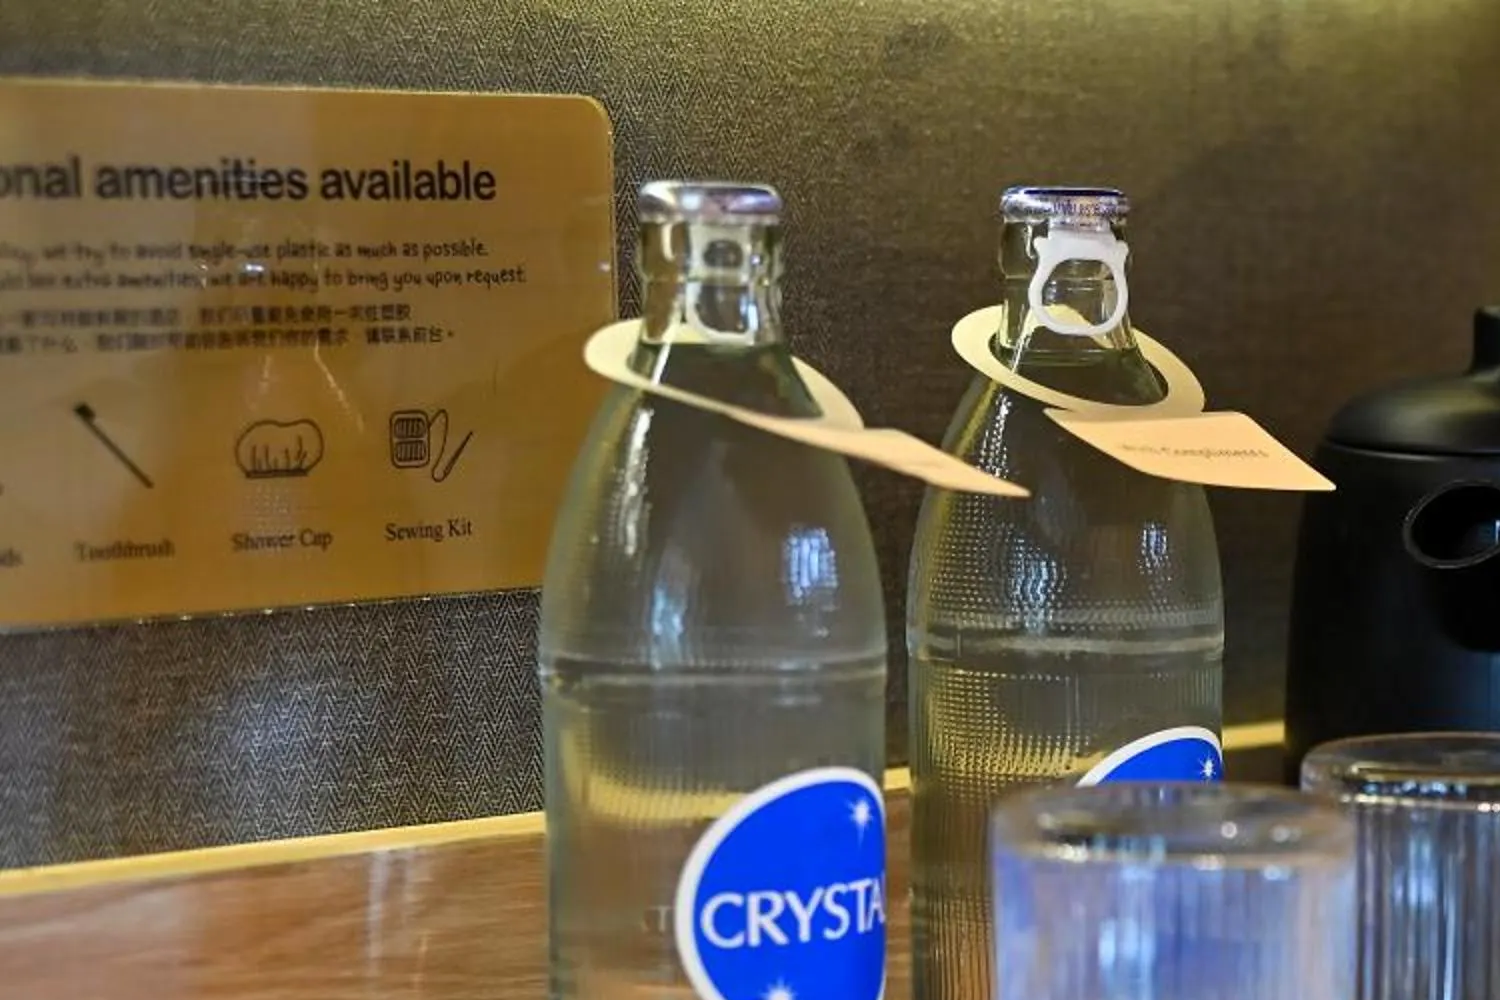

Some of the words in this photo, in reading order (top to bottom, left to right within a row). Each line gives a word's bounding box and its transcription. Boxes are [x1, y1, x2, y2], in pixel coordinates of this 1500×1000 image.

[96, 156, 309, 200] amenities
[320, 159, 497, 201] available
[335, 242, 351, 258] as
[357, 240, 398, 260] much
[402, 240, 419, 257] as
[270, 267, 319, 293] happy
[324, 266, 343, 287] to
[347, 268, 389, 292] bring
[393, 272, 422, 293] you
[425, 271, 462, 288] upon
[231, 530, 296, 551] Shower
[299, 527, 334, 551] Cap
[384, 521, 444, 543] Sewing
[449, 518, 473, 538] Kit
[700, 872, 886, 949] CRYSTA
